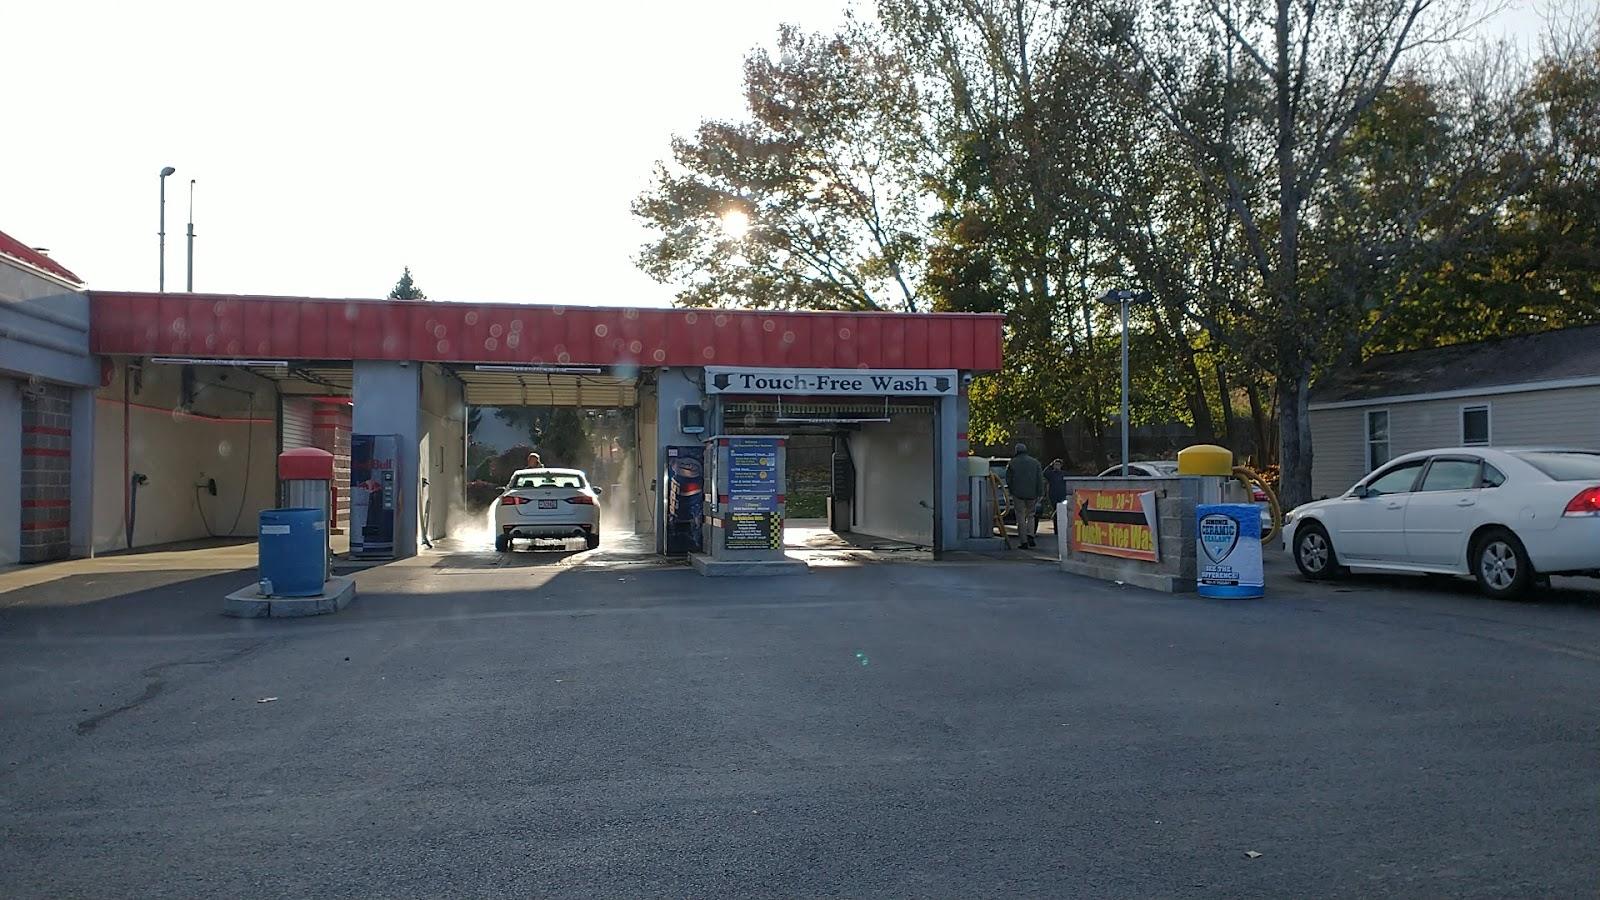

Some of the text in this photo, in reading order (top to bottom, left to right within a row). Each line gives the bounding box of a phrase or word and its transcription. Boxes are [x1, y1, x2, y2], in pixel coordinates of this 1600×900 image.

[740, 374, 928, 391] Touch-Free Wash
[1096, 494, 1113, 510] Open
[1202, 525, 1235, 535] CERAMIC
